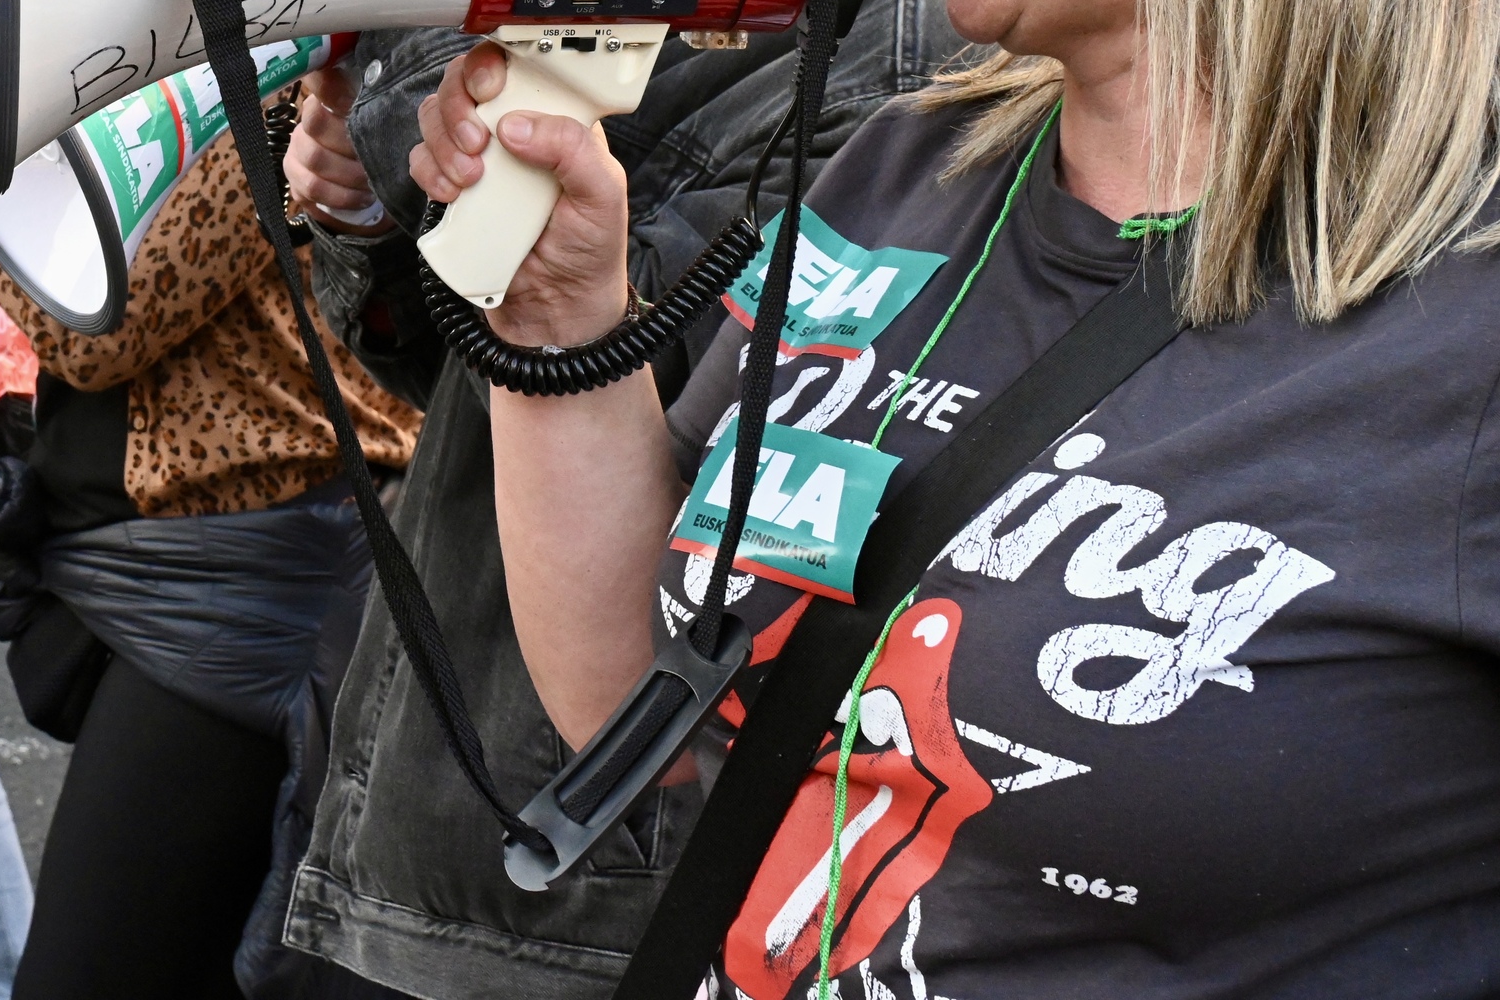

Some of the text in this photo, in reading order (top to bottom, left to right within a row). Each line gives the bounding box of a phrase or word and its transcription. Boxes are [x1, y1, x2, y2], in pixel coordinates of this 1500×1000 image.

[112, 133, 139, 215] SINDIKATUA
[756, 232, 900, 319] ELA
[866, 369, 981, 433] THE
[693, 513, 828, 570] EUSK SINDIKATUA
[930, 432, 1337, 725] ing
[1040, 866, 1139, 906] 1962
